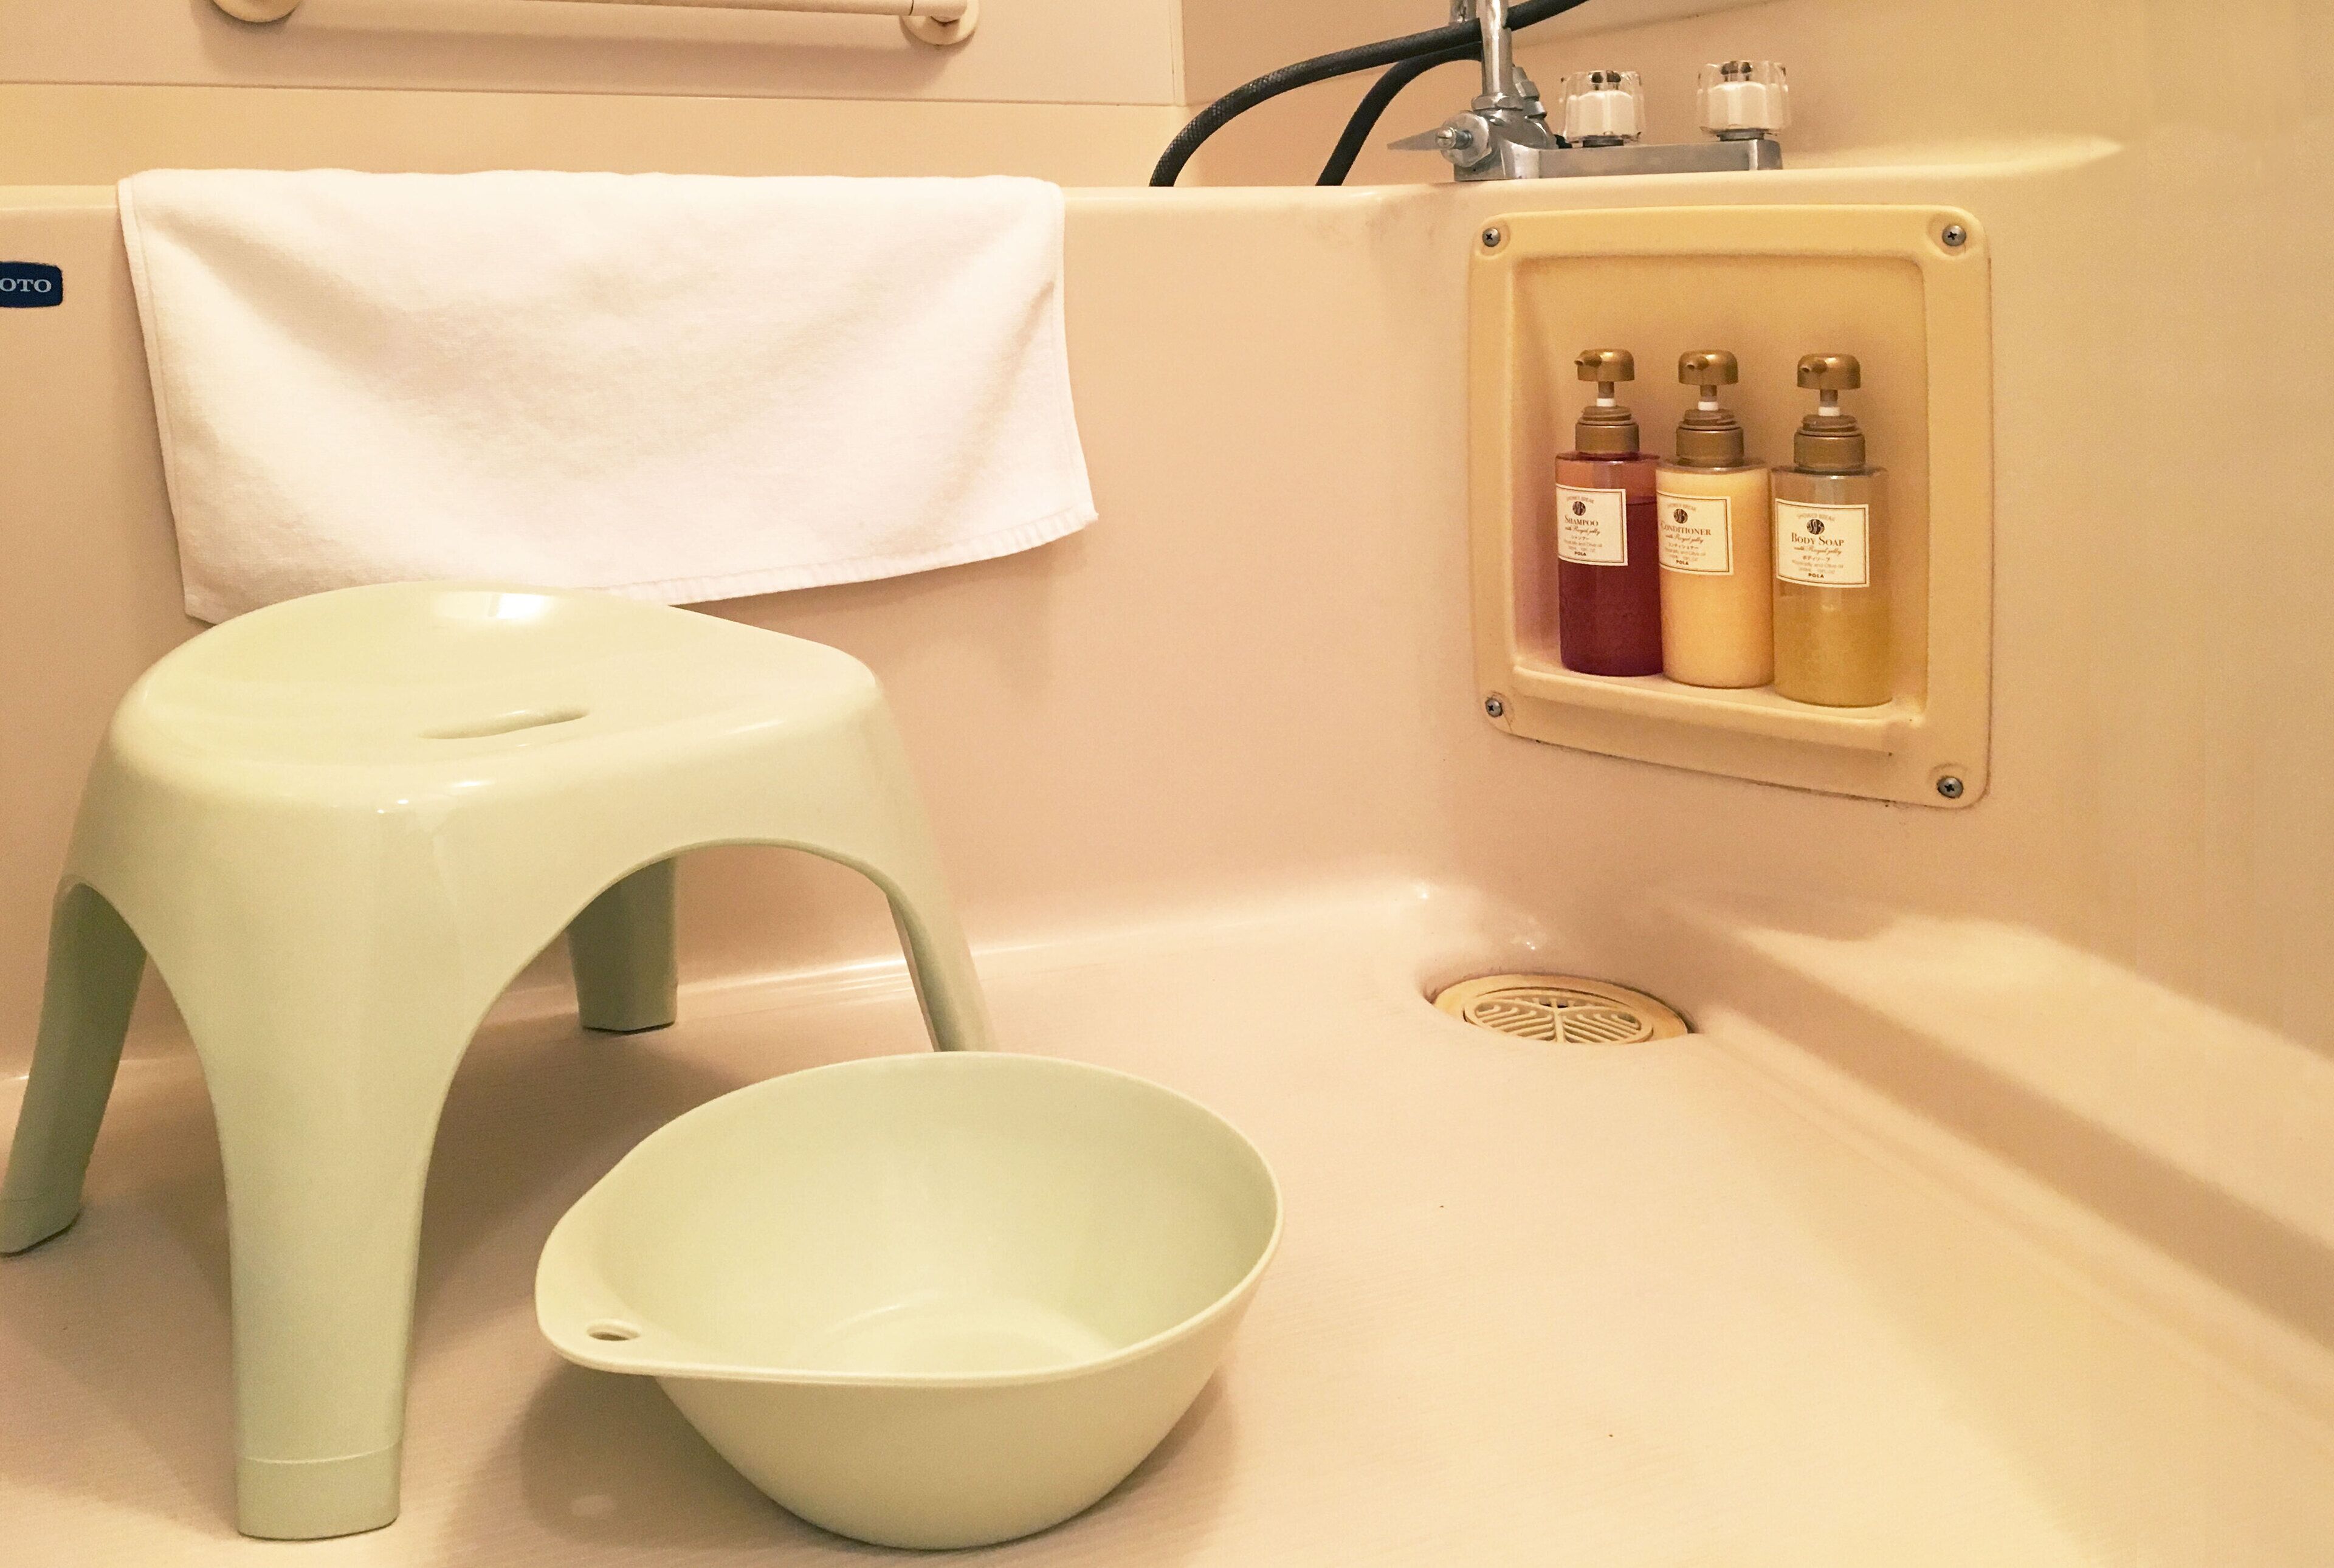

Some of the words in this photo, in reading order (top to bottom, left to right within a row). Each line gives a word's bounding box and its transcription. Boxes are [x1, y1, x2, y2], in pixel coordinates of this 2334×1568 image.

[1565, 515, 1599, 526] SHAMPOO
[1661, 521, 1711, 535] CONDITIONER
[1791, 532, 1815, 545] BODY
[1819, 535, 1844, 546] SOAP
